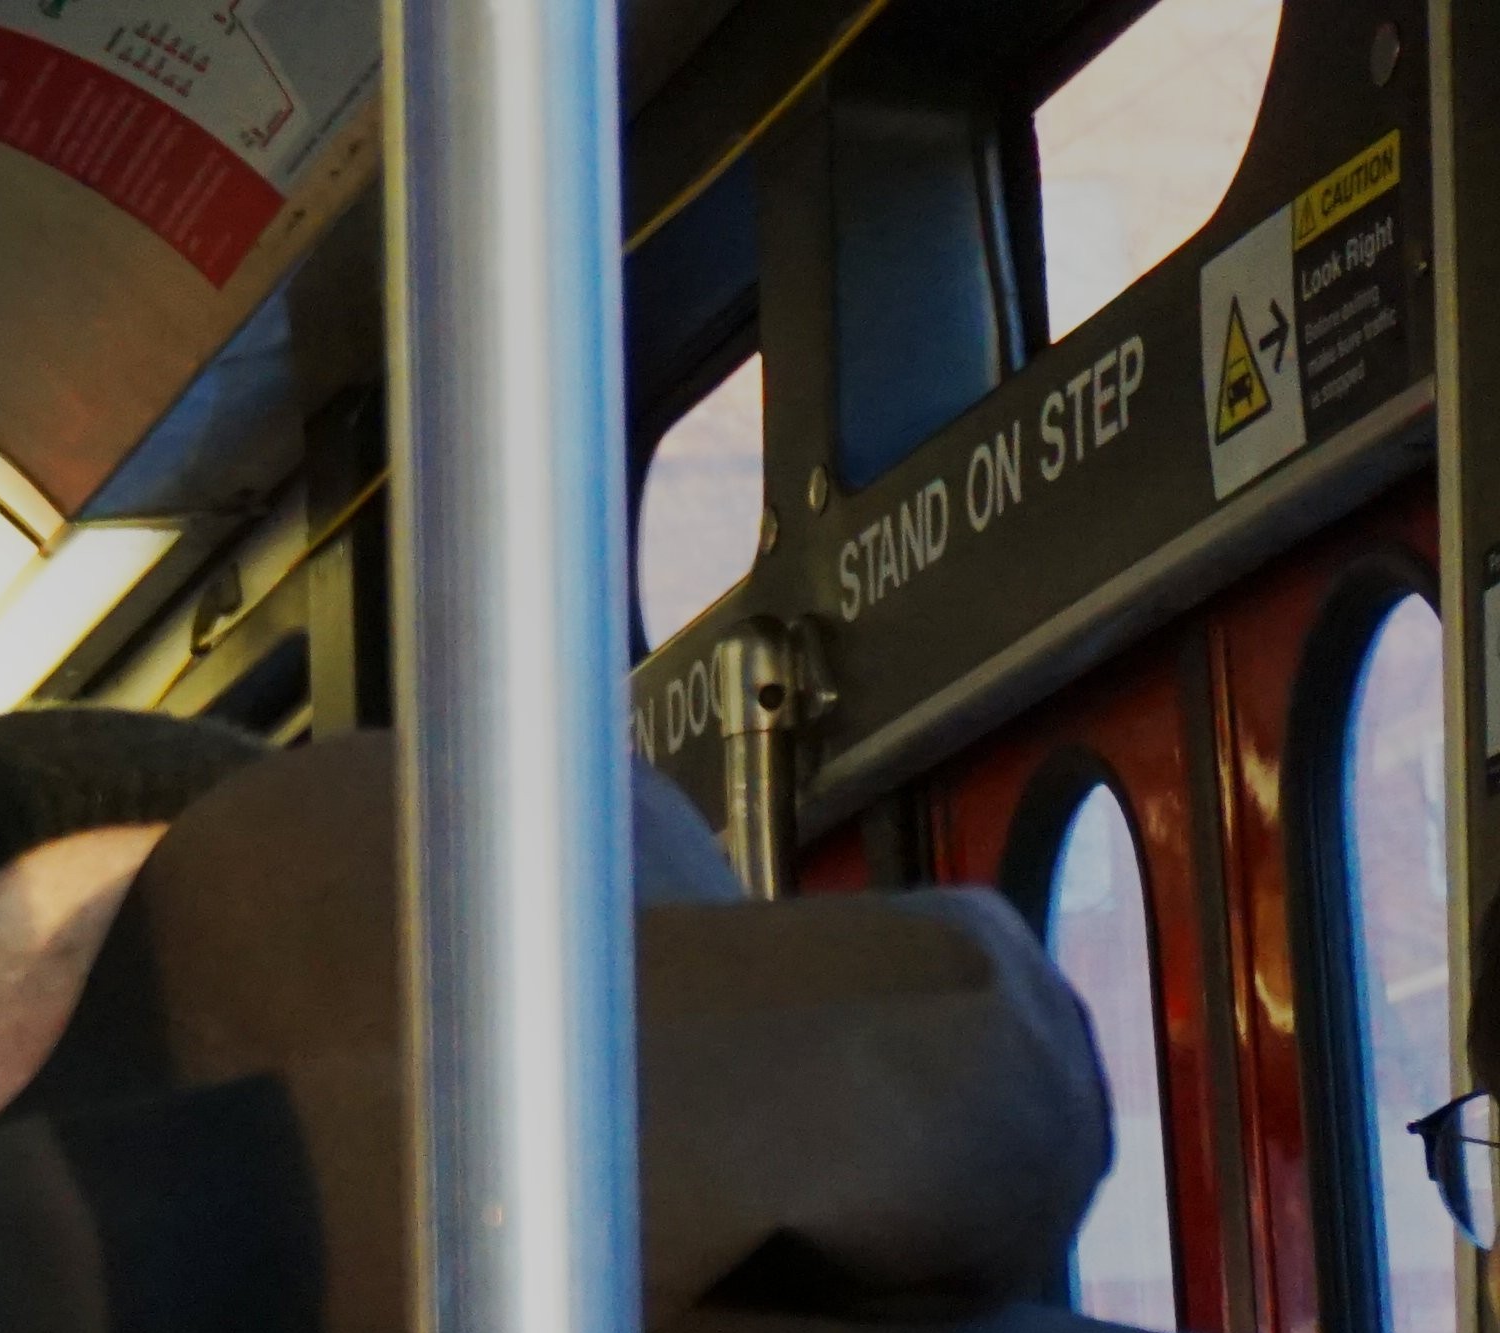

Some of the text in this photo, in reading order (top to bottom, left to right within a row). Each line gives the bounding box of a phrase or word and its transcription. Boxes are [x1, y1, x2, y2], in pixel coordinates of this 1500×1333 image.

[1320, 146, 1395, 218] CAUTION
[1301, 215, 1395, 303] Look Right
[838, 335, 1145, 624] STAND ON STEP
